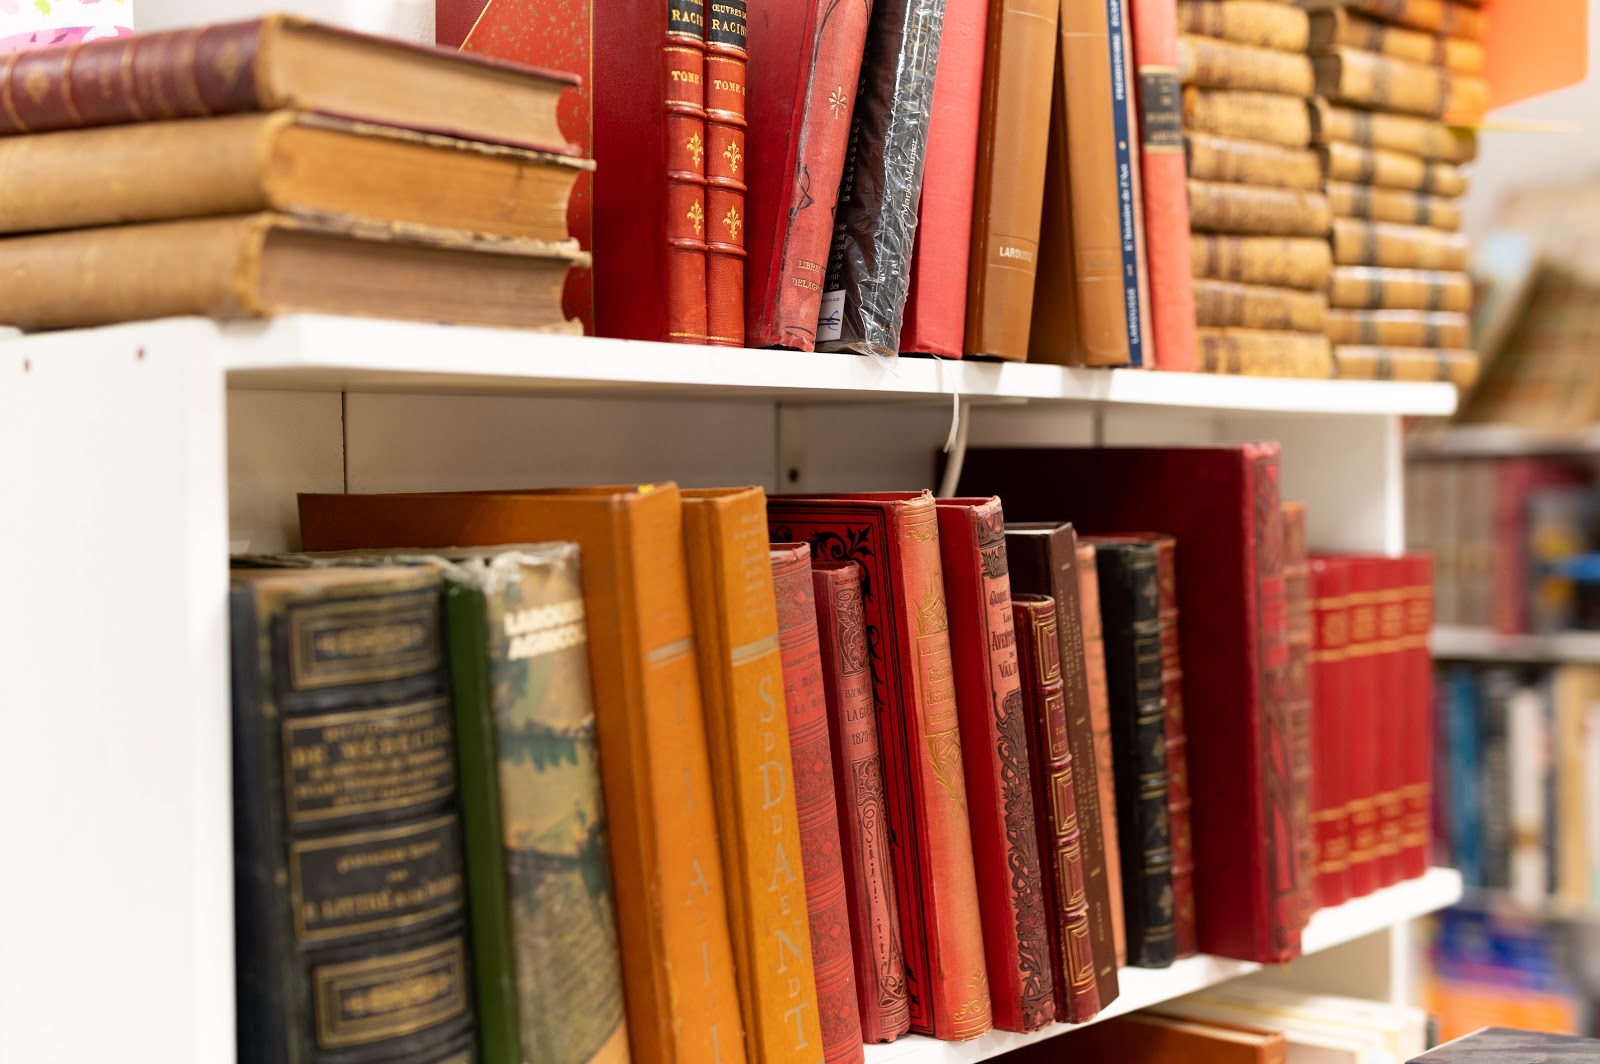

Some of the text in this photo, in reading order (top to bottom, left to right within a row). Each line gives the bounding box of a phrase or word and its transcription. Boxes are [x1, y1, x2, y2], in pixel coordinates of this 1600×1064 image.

[711, 18, 747, 37] RACIN
[671, 70, 700, 84] TOME
[714, 79, 741, 94] TOME
[904, 138, 919, 185] Meunier
[846, 707, 859, 722] LA
